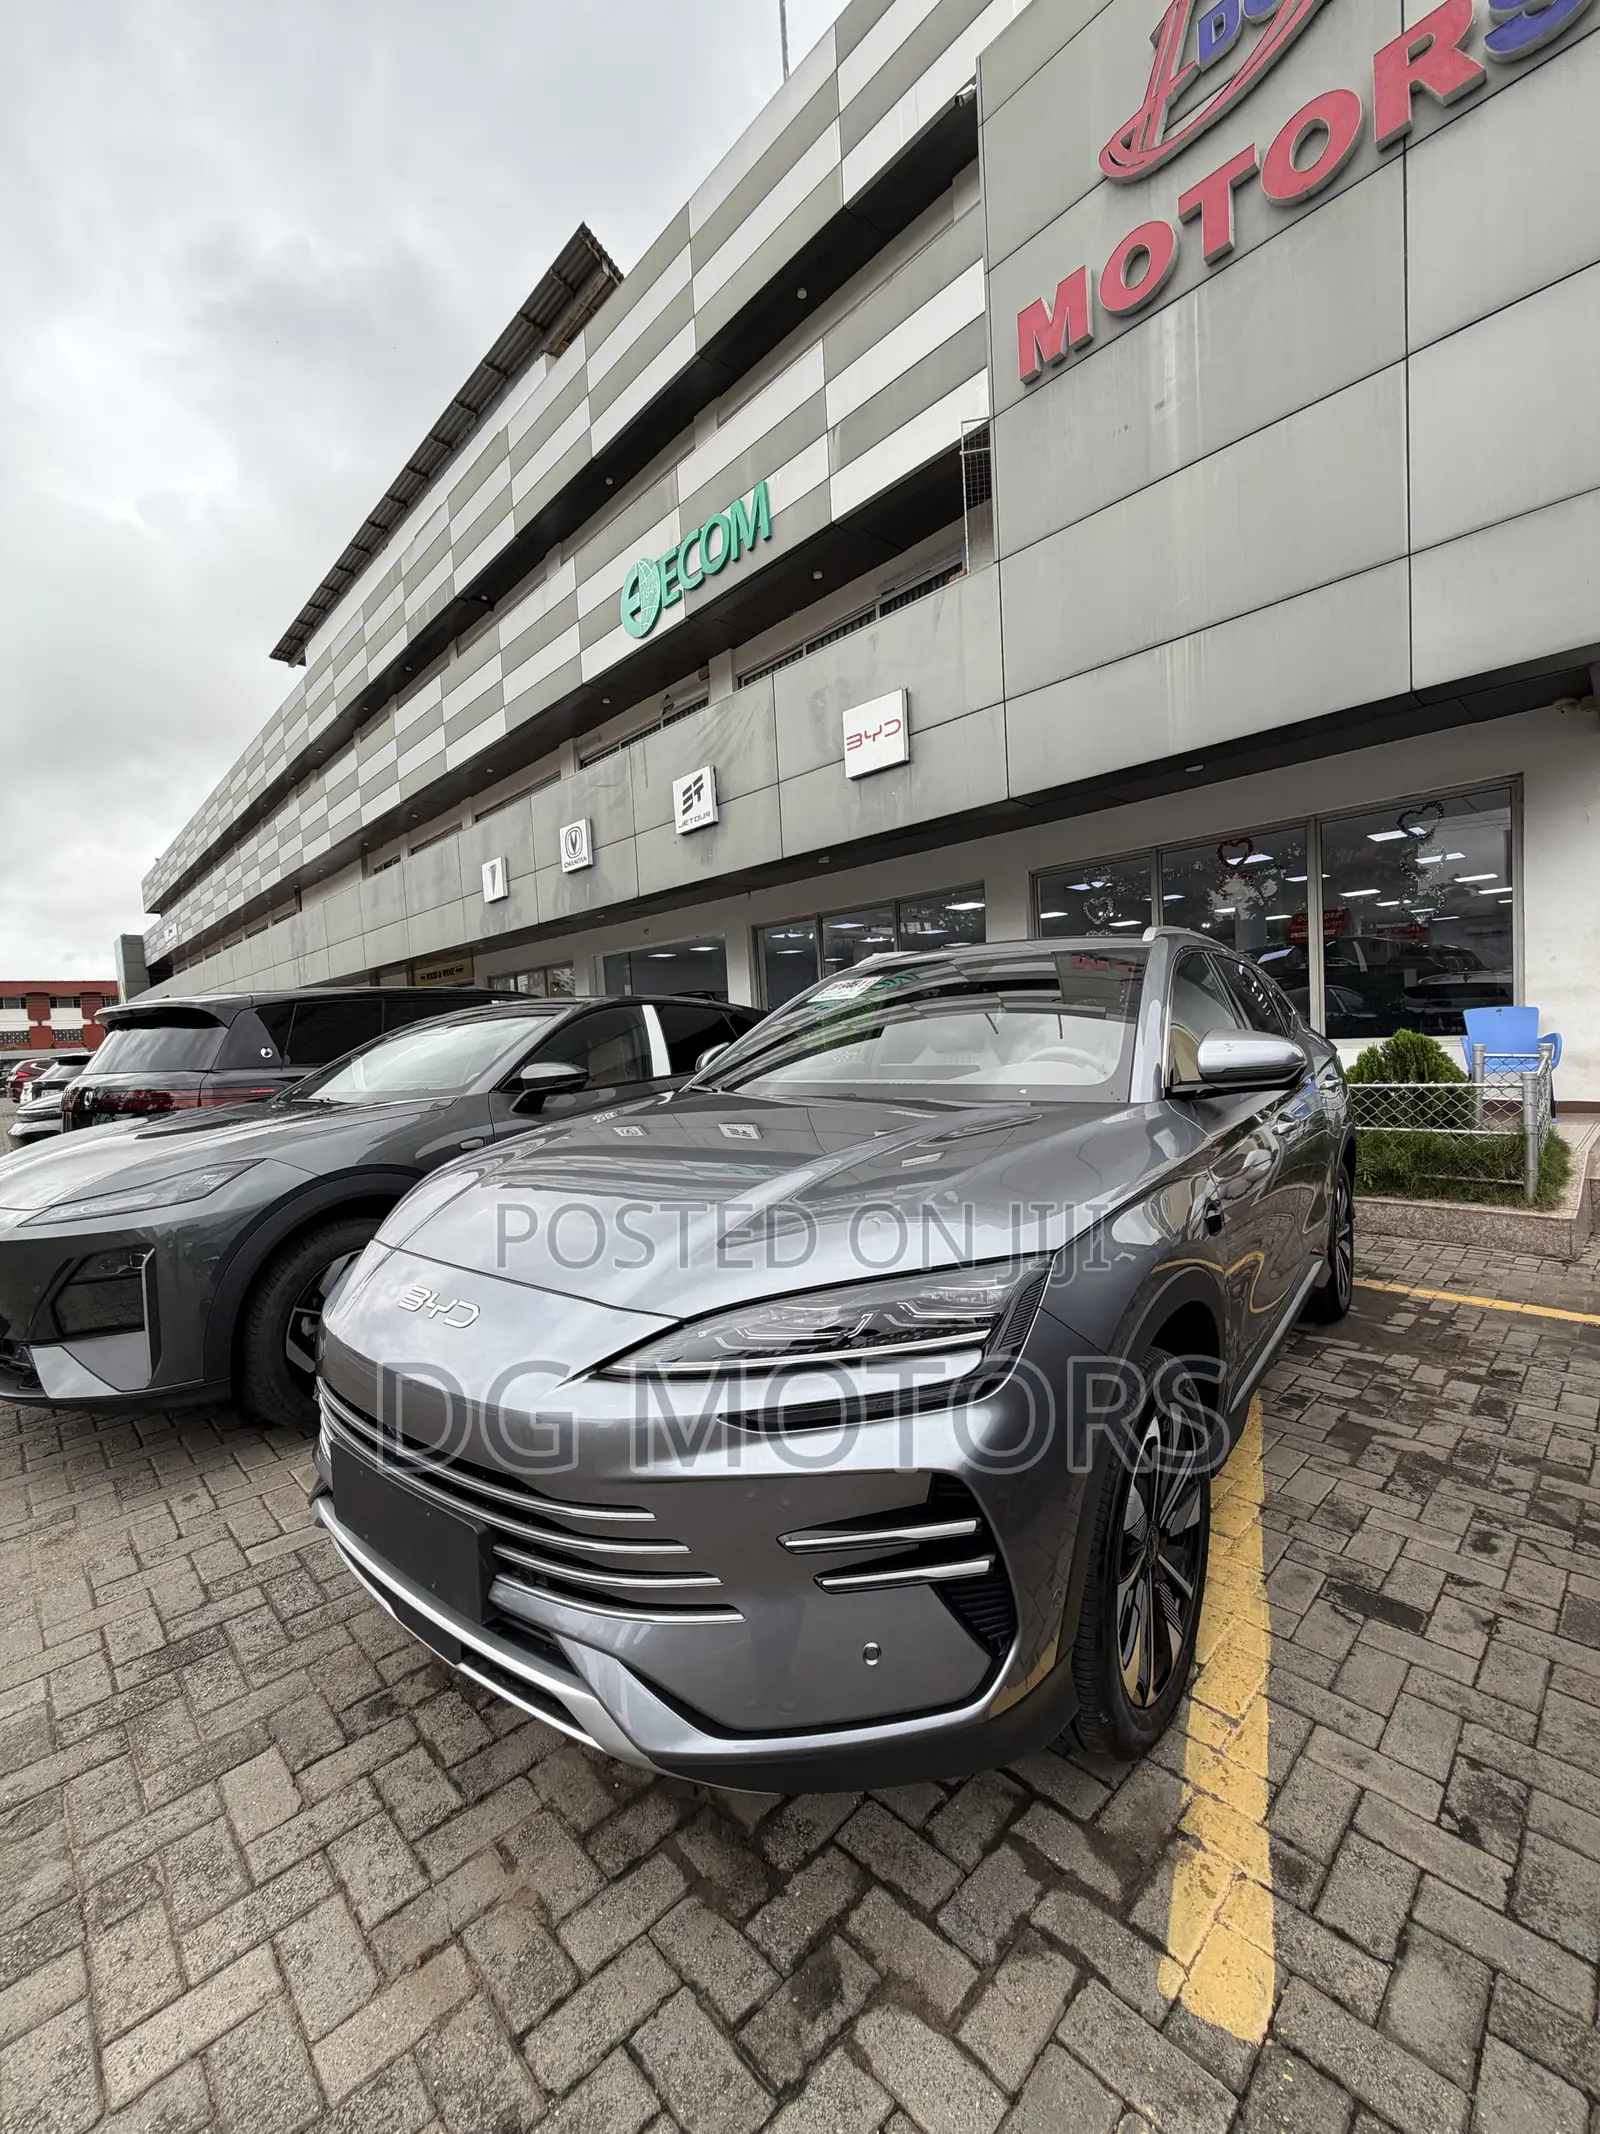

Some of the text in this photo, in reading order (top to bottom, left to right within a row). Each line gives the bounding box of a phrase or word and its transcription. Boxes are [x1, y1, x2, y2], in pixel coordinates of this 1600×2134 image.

[1197, 0, 1280, 66] D
[660, 479, 772, 609] ECOM
[846, 719, 901, 752] BYD
[679, 811, 711, 828] JETOUR
[397, 1284, 480, 1329] BYD
